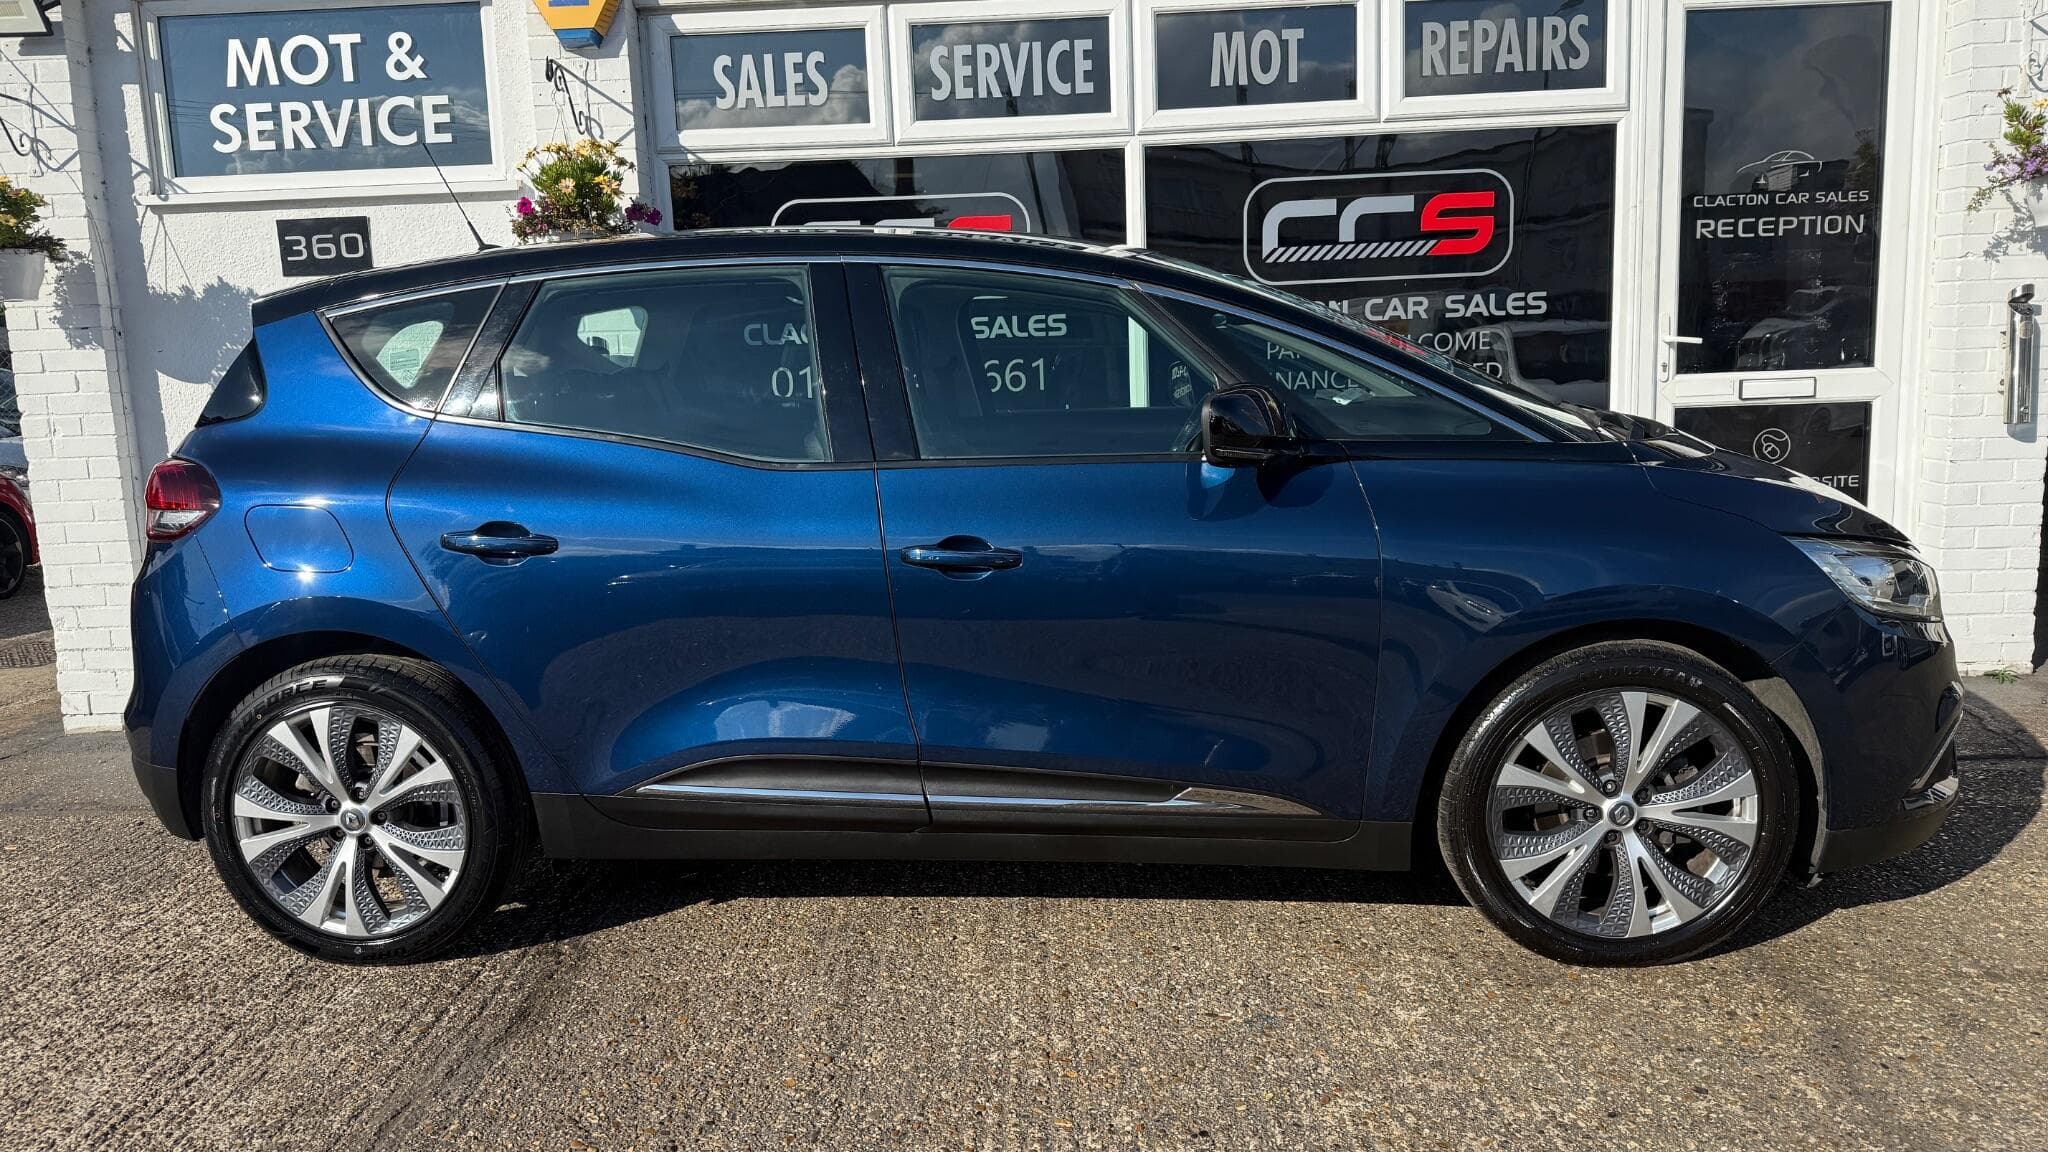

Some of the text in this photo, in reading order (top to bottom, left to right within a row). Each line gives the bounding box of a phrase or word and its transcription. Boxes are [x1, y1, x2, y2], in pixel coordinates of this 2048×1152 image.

[226, 31, 428, 87] MOT &
[929, 38, 1094, 101] SERVICE
[1210, 28, 1304, 87] MOT
[1422, 14, 1590, 76] REPAIRS
[713, 50, 829, 110] SALES
[210, 94, 453, 154] SERVICE
[1693, 190, 1870, 208] CLACTON CAR SALES
[1695, 214, 1865, 240] RECEPTION
[284, 233, 364, 261] 360
[970, 313, 1068, 339] SALES
[1364, 296, 1429, 321] CAR
[1445, 291, 1547, 318] SALES
